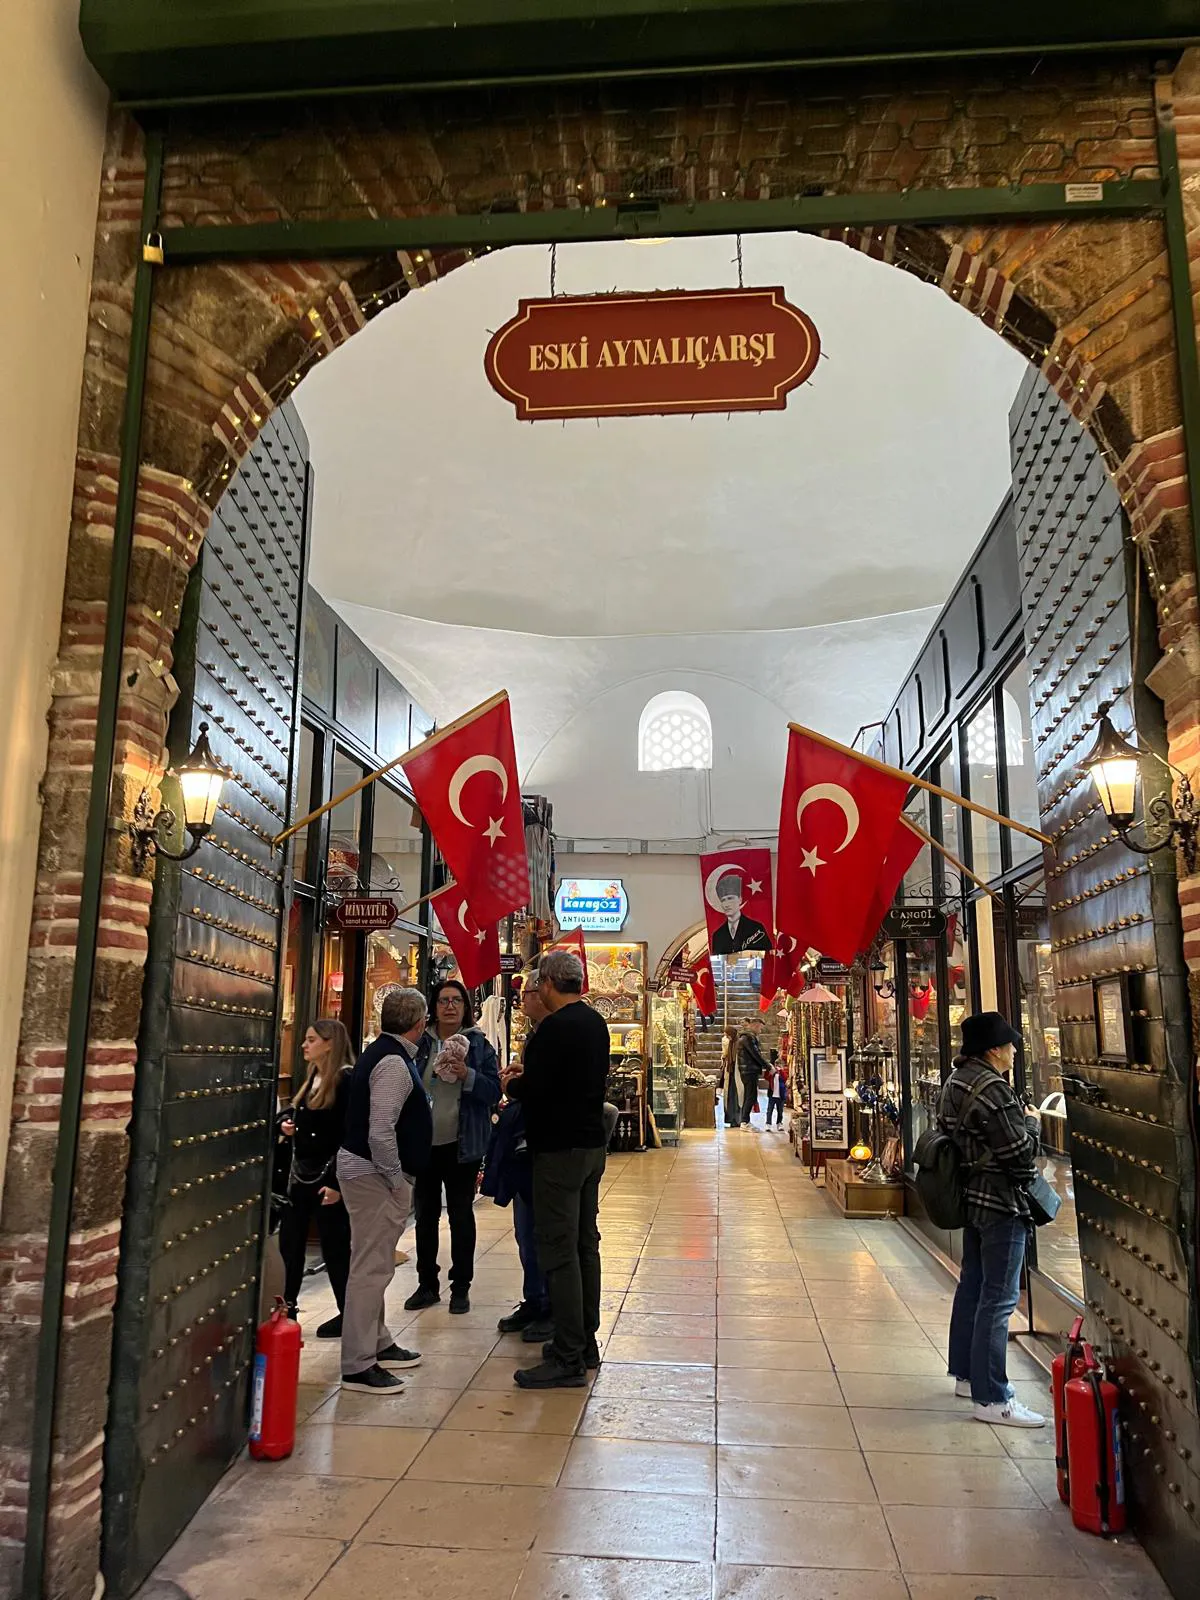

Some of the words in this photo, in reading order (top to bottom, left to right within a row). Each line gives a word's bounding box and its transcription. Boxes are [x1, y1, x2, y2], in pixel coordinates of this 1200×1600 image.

[529, 336, 589, 371] ESKİ
[596, 333, 776, 369] AYNALIÇARŞI
[345, 902, 388, 917] MİNYATÜR
[564, 897, 617, 912] karagöz
[562, 916, 597, 924] ANTIQUE
[599, 916, 620, 924] SHOP
[815, 1099, 843, 1111] daily
[815, 1108, 844, 1117] tours
